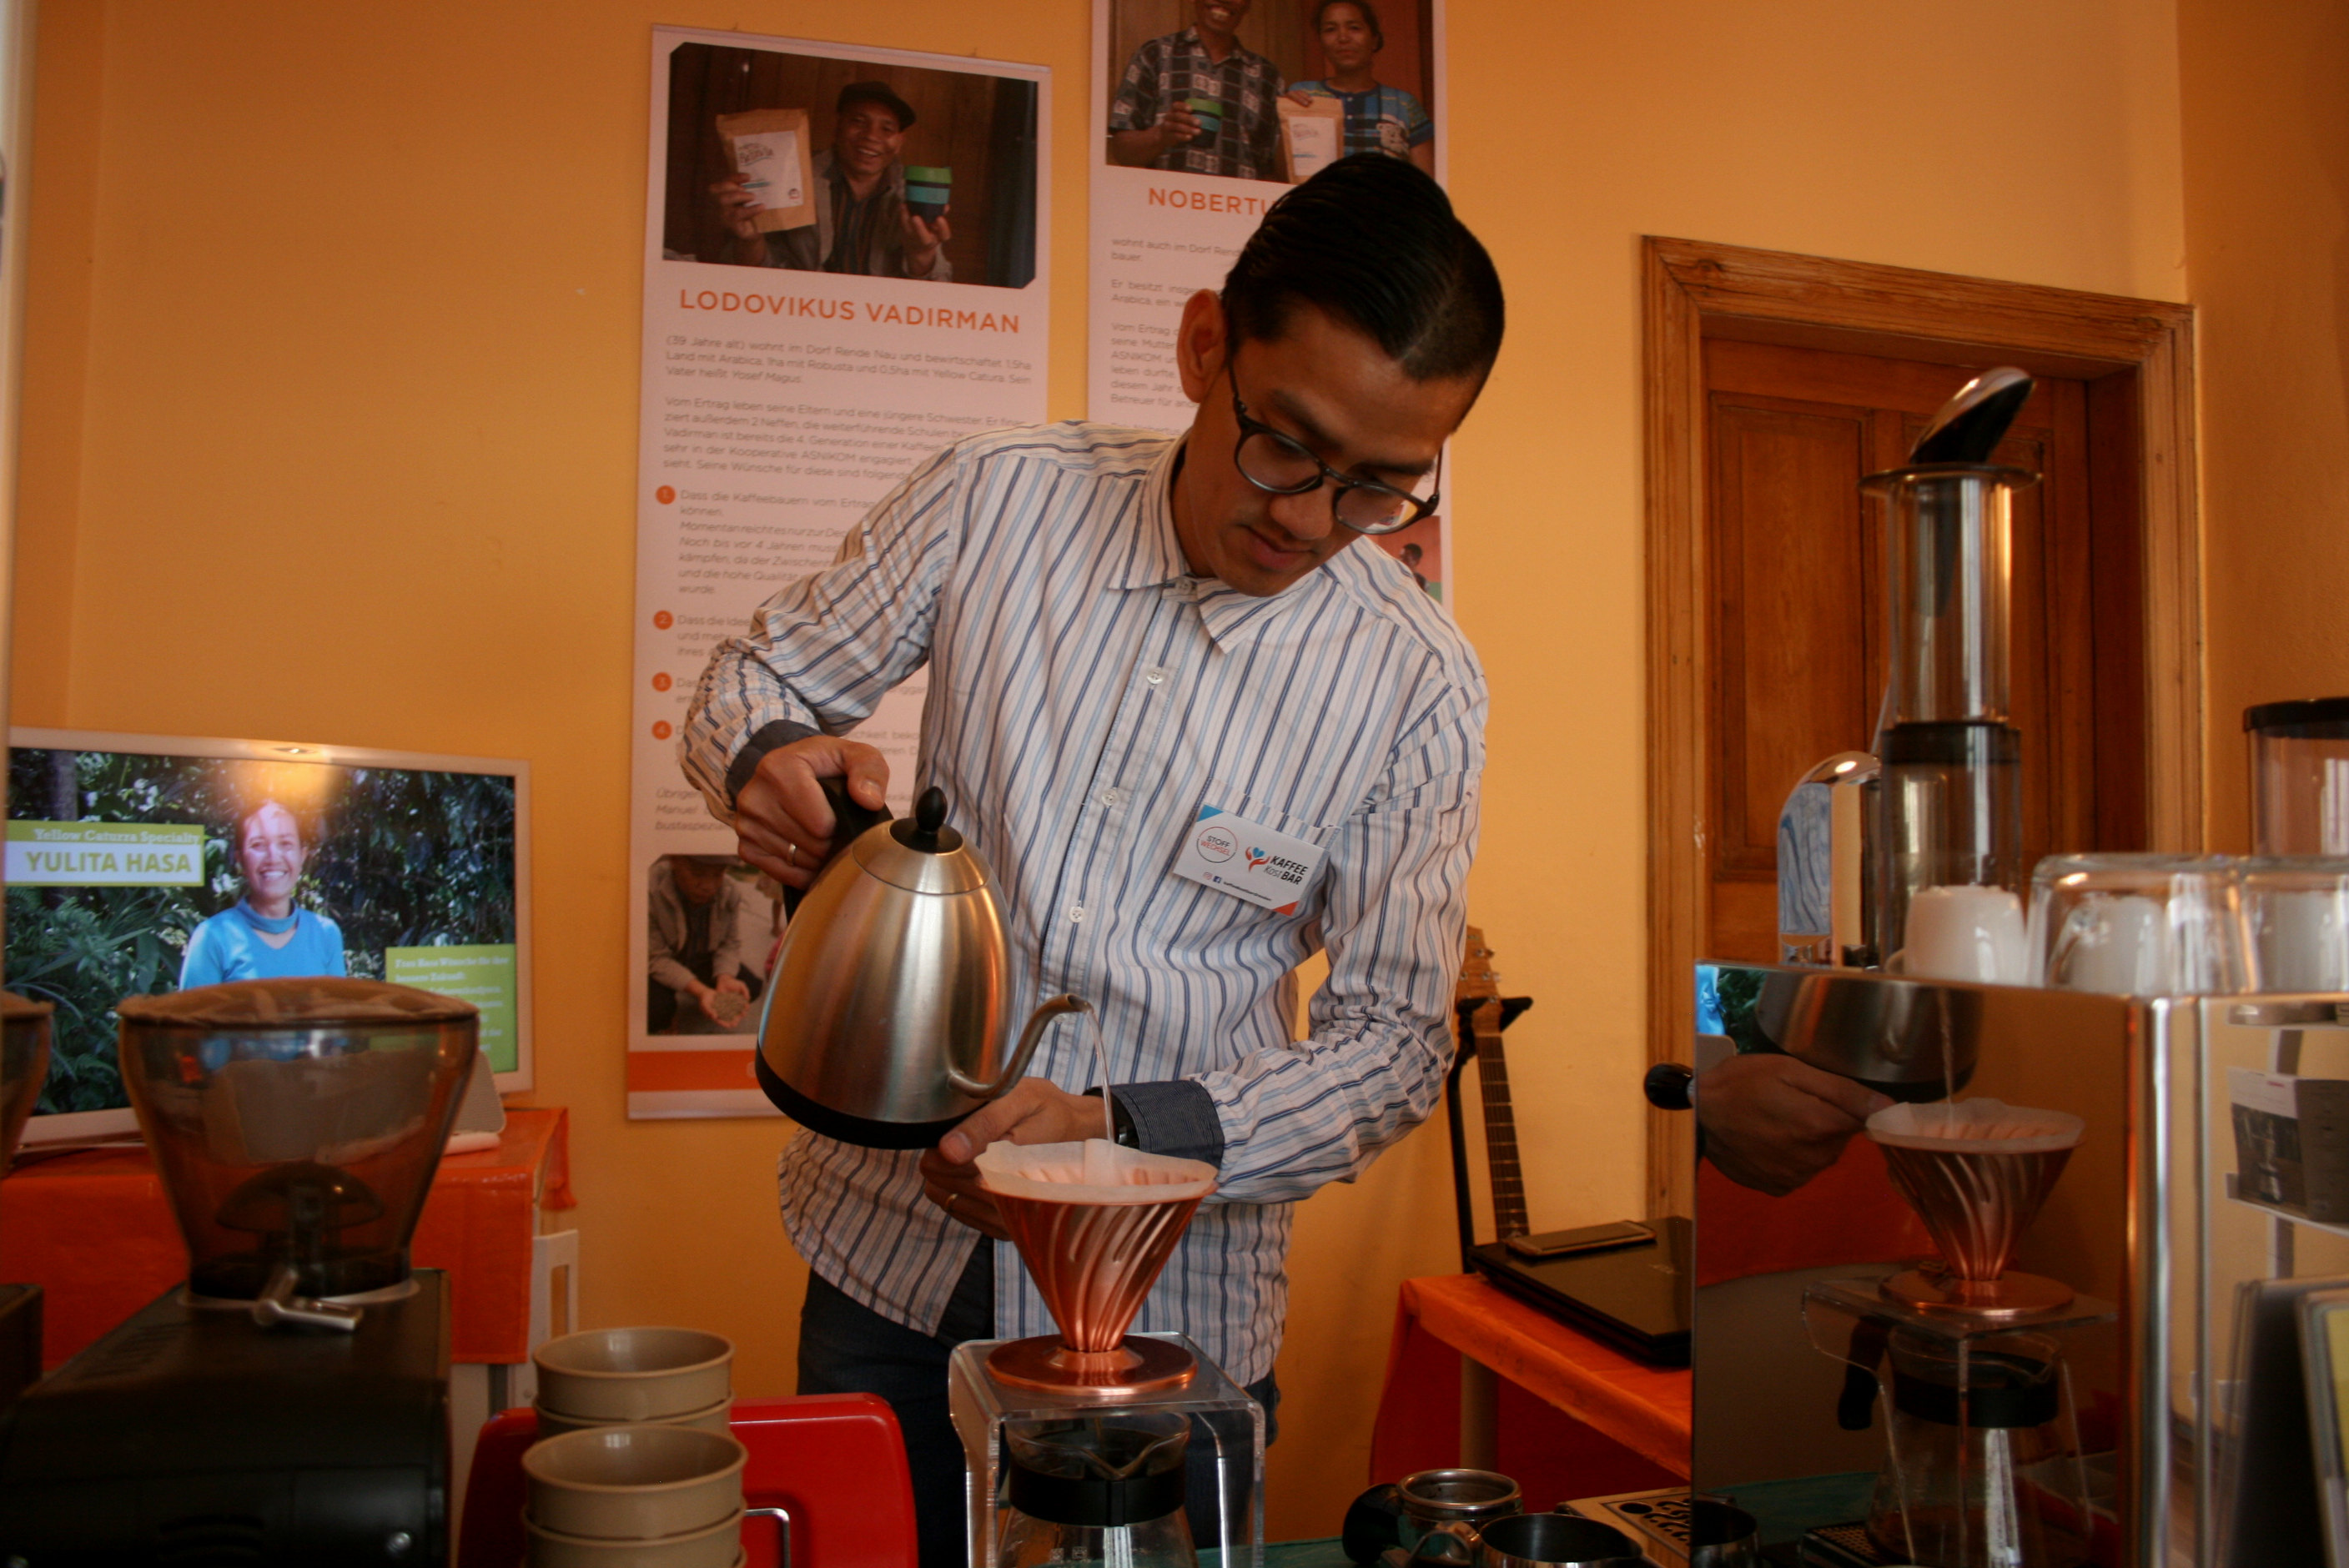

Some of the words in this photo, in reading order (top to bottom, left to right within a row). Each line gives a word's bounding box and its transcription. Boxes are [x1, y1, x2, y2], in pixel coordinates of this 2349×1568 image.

[1189, 243, 1212, 254] Dorf
[1111, 279, 1123, 289] Er
[680, 289, 855, 320] LODOVIKUS
[865, 302, 1019, 334] VADIRMAN
[1111, 322, 1135, 332] Vom
[1138, 323, 1170, 337] Ertrag
[691, 336, 722, 348] Jahre
[749, 341, 784, 352] wohnt
[788, 343, 802, 353] im
[806, 344, 831, 355] Dorf
[835, 346, 871, 358] Rende
[874, 349, 897, 359] Nau
[900, 351, 922, 361] und
[924, 353, 1002, 367] bewirtschaftet
[666, 351, 695, 361] Land
[697, 353, 716, 362] mit
[787, 359, 804, 369] mit
[807, 359, 854, 372] Robusta
[856, 364, 877, 374] und
[912, 368, 929, 377] mit
[932, 369, 966, 379] Yellow
[1009, 374, 1031, 384] Sein
[666, 366, 696, 376] Vater
[732, 369, 763, 380] Yosef
[1111, 379, 1148, 390] diesem
[1151, 382, 1174, 392] Jahr
[1110, 392, 1155, 405] Betreuer
[1158, 396, 1172, 407] für
[665, 396, 691, 406] Vom
[694, 397, 730, 411] Ertrag
[733, 400, 763, 410] leben
[766, 404, 796, 414] seine
[797, 404, 831, 415] Eltern
[833, 407, 855, 417] und
[858, 409, 881, 419] eine
[986, 415, 998, 426] Er
[692, 413, 749, 425] außerdem
[751, 416, 758, 426] 2
[802, 420, 820, 430] die
[822, 422, 905, 435] weiterführende
[908, 426, 949, 438] Schulen
[663, 427, 718, 439] Vadirman
[720, 430, 734, 440] ist
[736, 431, 775, 442] bereits
[777, 434, 795, 444] die
[808, 435, 869, 448] Generation
[871, 440, 898, 449] einer
[663, 443, 687, 453] sehr
[692, 445, 702, 454] in
[707, 445, 725, 455] der
[729, 446, 797, 460] Kooperative
[697, 460, 727, 470] Seine
[731, 460, 782, 474] Wünsche
[786, 464, 802, 475] für
[803, 466, 834, 475] diese
[837, 468, 860, 478] sind
[681, 489, 707, 500] Dass
[712, 490, 729, 501] die
[733, 493, 808, 505] Kaffeebauern
[812, 498, 837, 507] vom
[680, 536, 709, 547] Noch
[713, 538, 729, 548] bis
[734, 540, 752, 549] vor
[755, 540, 763, 549] 4
[767, 540, 805, 551] Jahren
[734, 555, 748, 565] da
[751, 555, 770, 565] der
[678, 570, 701, 579] und
[702, 569, 721, 579] die
[722, 570, 751, 580] hohe
[677, 614, 705, 625] Dass
[707, 616, 725, 626] die
[677, 632, 700, 641] und
[33, 827, 83, 841] Yellow
[84, 828, 138, 842] Caturra
[140, 830, 201, 845] Specialty
[1206, 835, 1231, 847] STOFF
[1200, 839, 1230, 857] WECHSEL
[25, 851, 118, 872] YULITA
[126, 852, 192, 873] HASA
[1270, 855, 1309, 877] KAFFEE
